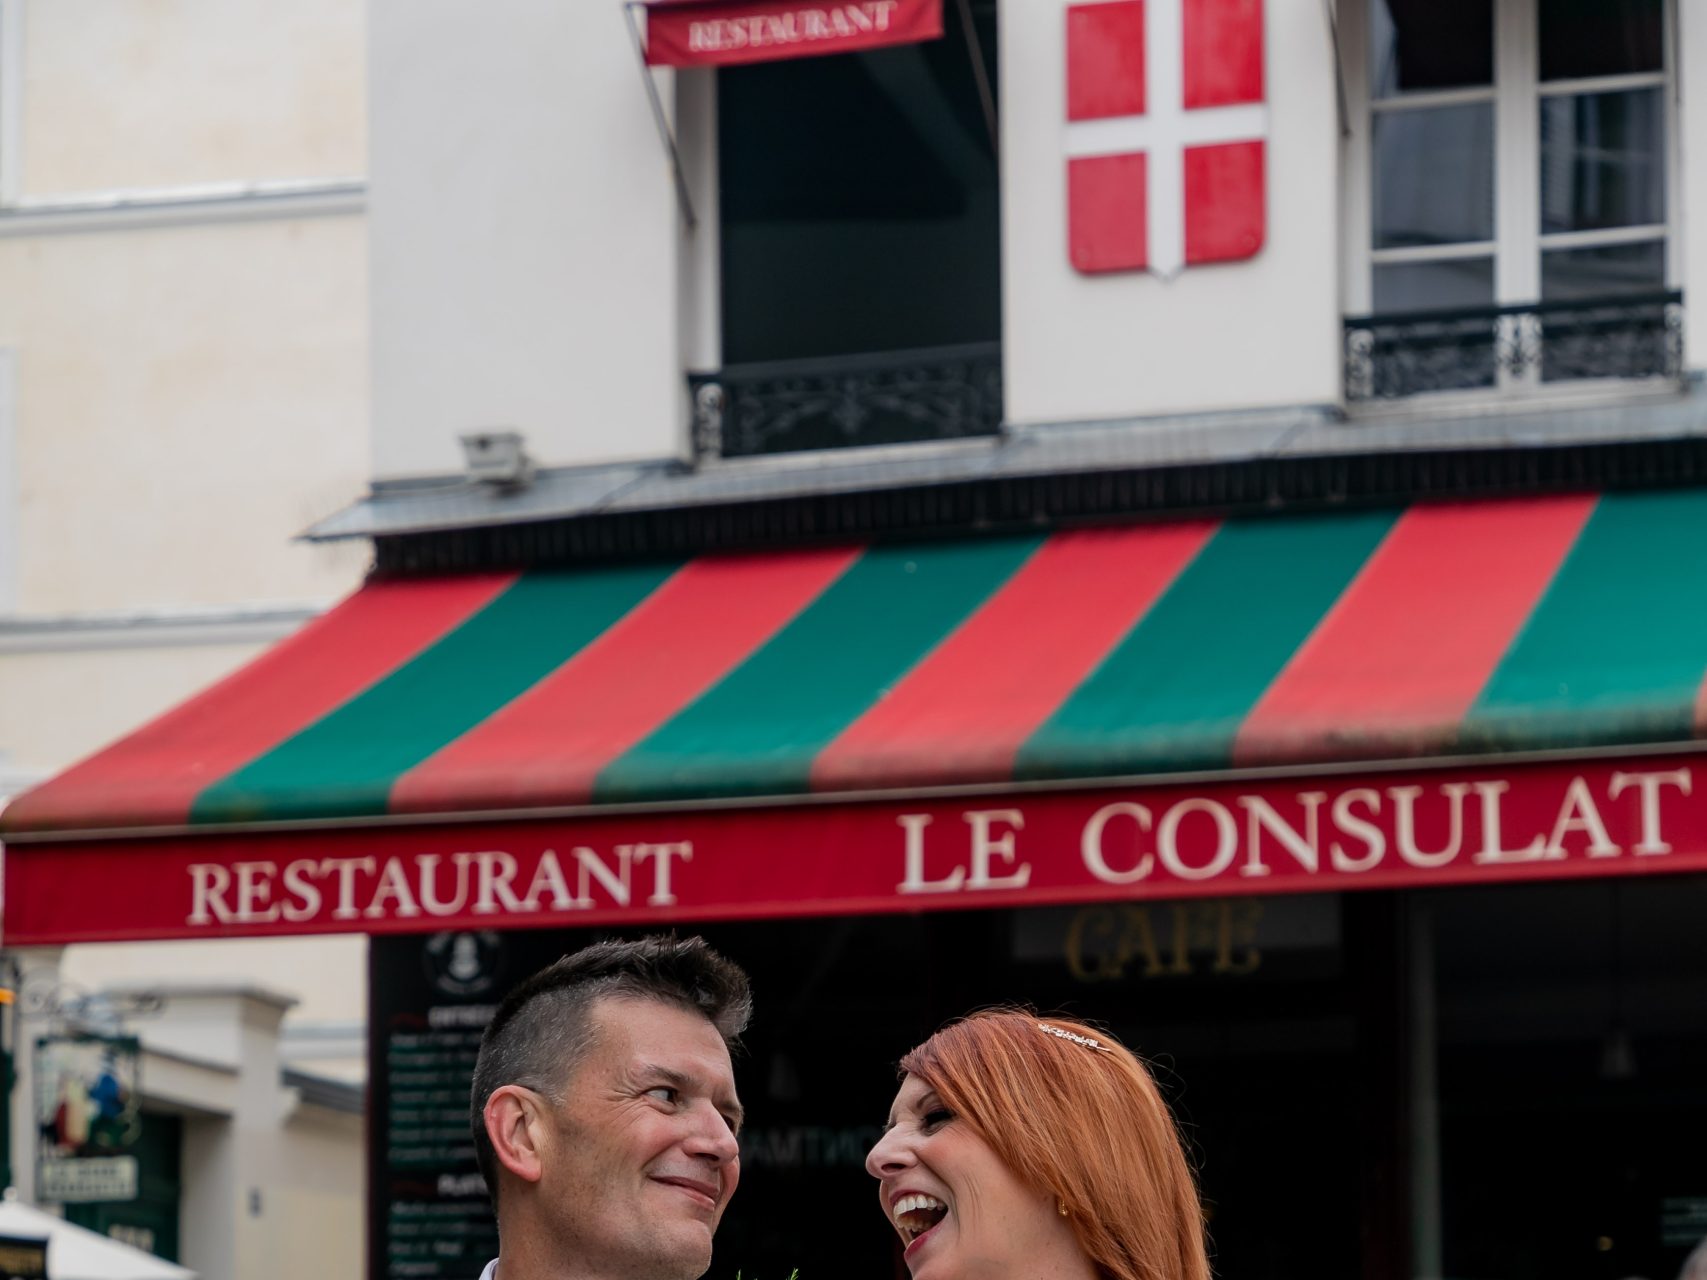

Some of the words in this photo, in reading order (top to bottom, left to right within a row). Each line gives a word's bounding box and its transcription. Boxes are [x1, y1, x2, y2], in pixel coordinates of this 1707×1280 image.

[688, 1, 897, 51] RESTAURANT
[187, 841, 693, 926] RESTAURANT
[896, 808, 1032, 895] LE
[1080, 767, 1693, 884] CONSULAT
